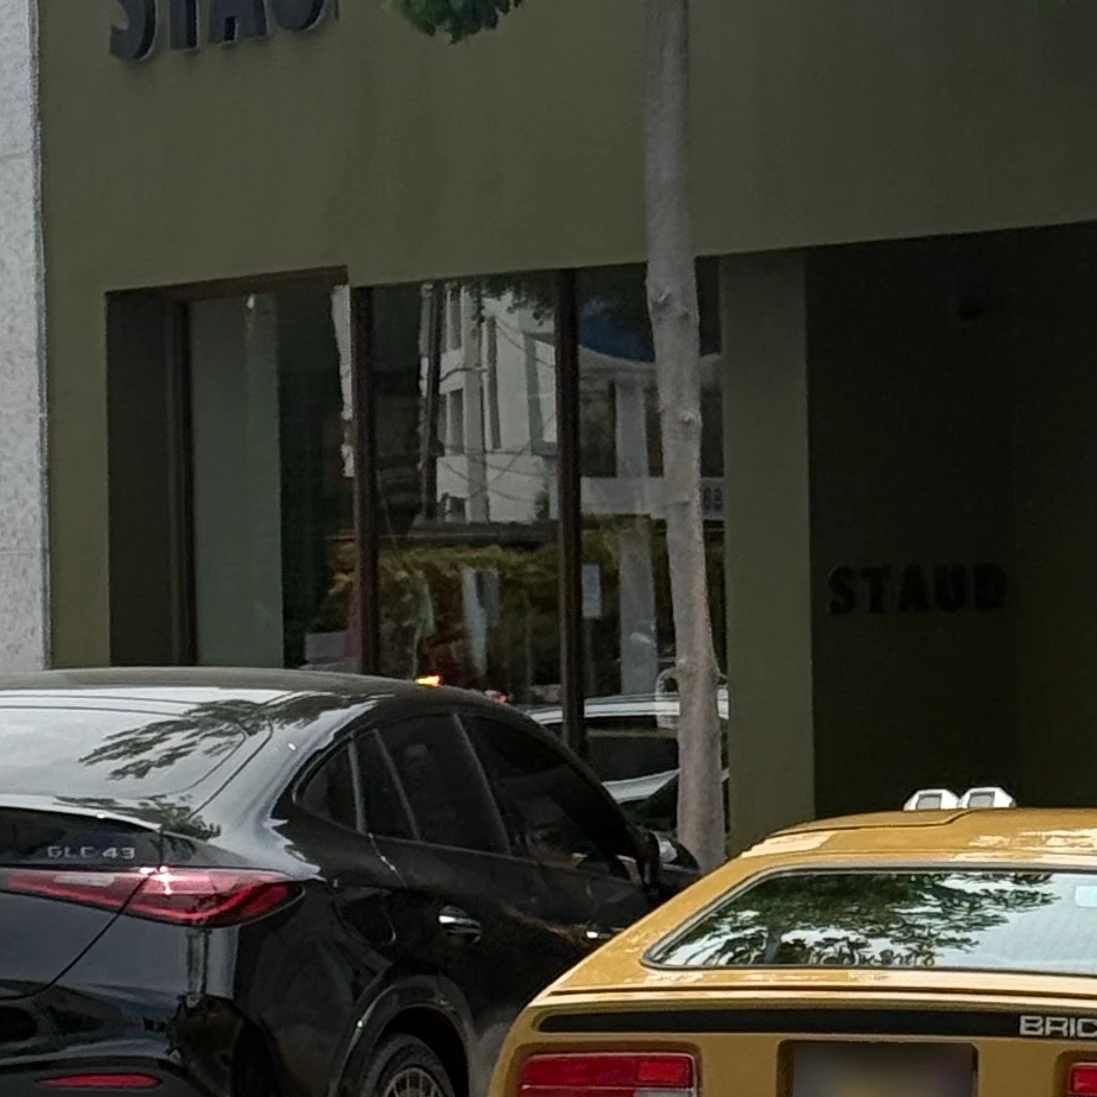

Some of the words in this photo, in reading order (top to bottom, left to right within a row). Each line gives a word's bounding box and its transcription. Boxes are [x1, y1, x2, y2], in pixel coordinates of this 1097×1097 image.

[827, 562, 1007, 614] STAUD
[47, 845, 95, 859] GLC
[101, 846, 136, 861] 43
